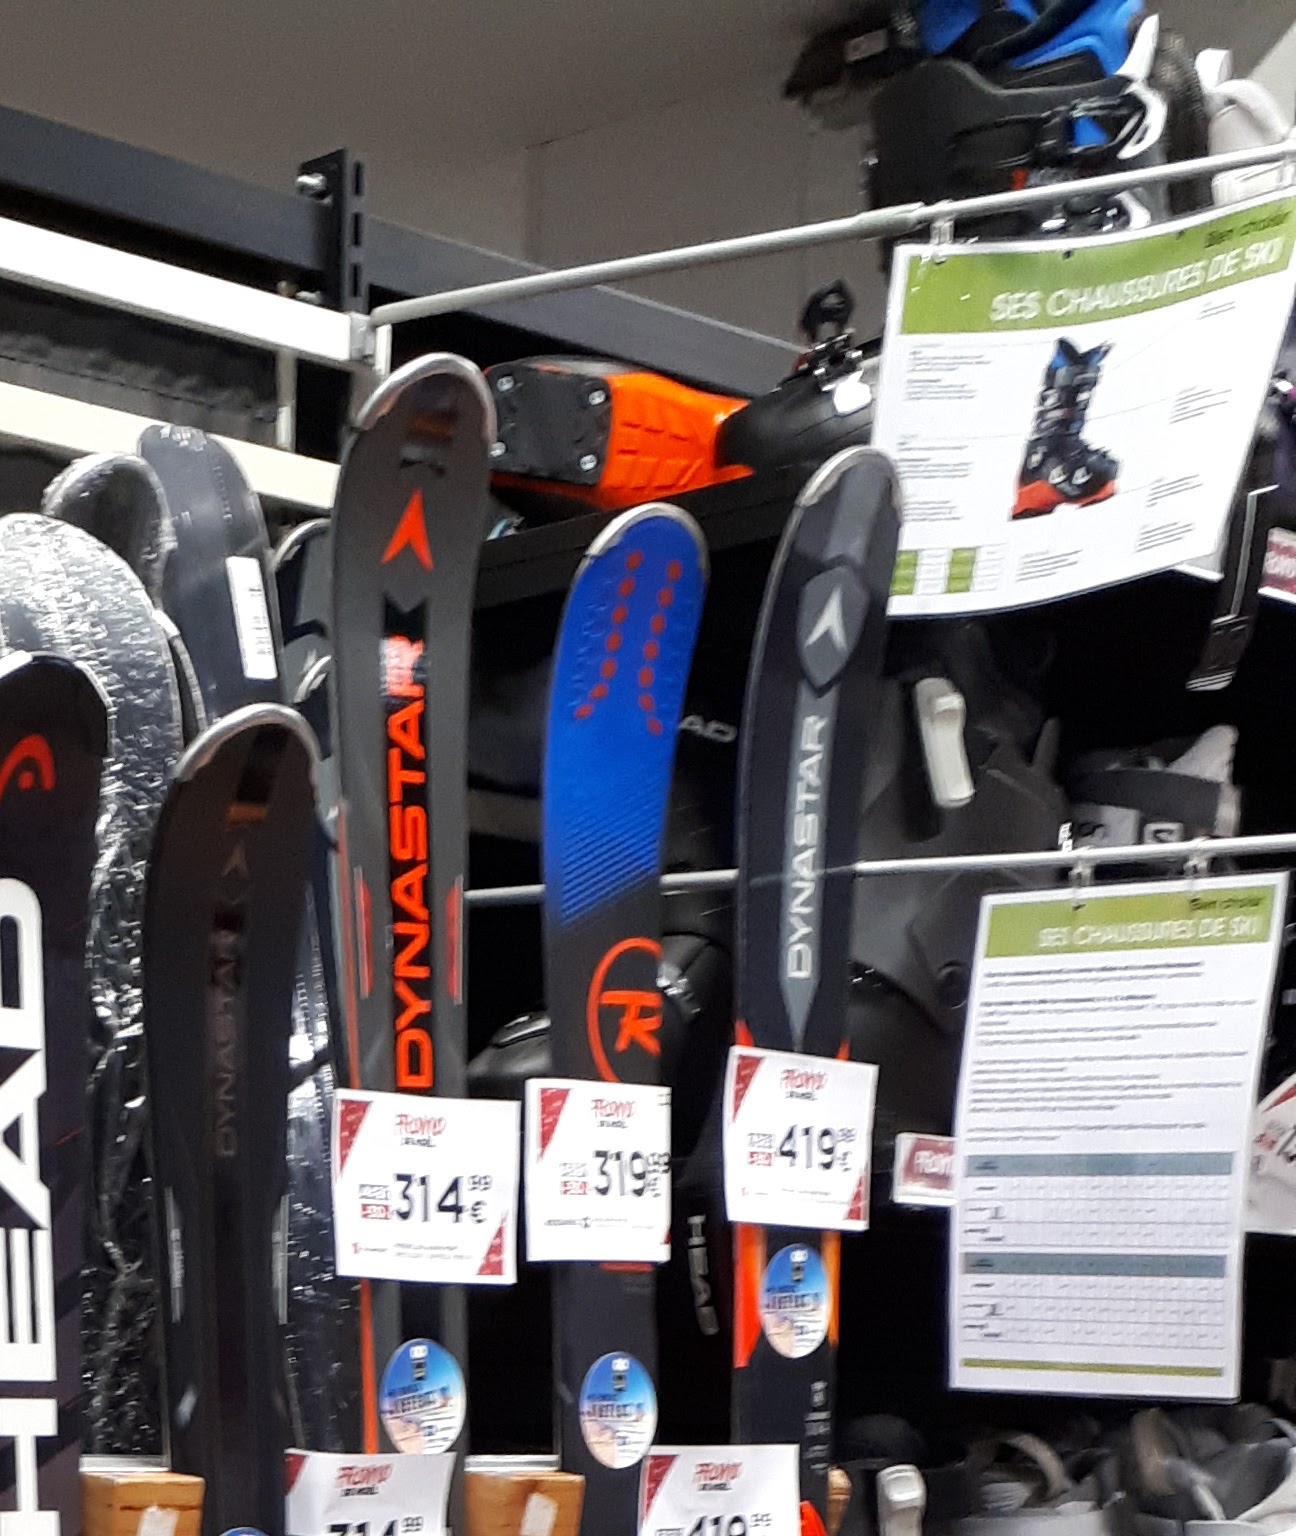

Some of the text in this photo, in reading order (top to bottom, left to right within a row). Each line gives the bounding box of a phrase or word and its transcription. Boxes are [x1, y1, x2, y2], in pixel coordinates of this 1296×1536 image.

[990, 290, 1041, 322] SES
[1046, 263, 1202, 317] CHAUSSURES
[1205, 251, 1240, 282] DE
[387, 635, 433, 1088] DYNASTAR
[787, 715, 828, 979] DYNASTAR
[593, 1150, 647, 1197] 319
[776, 1124, 835, 1170] 419
[393, 1172, 465, 1223] 314
